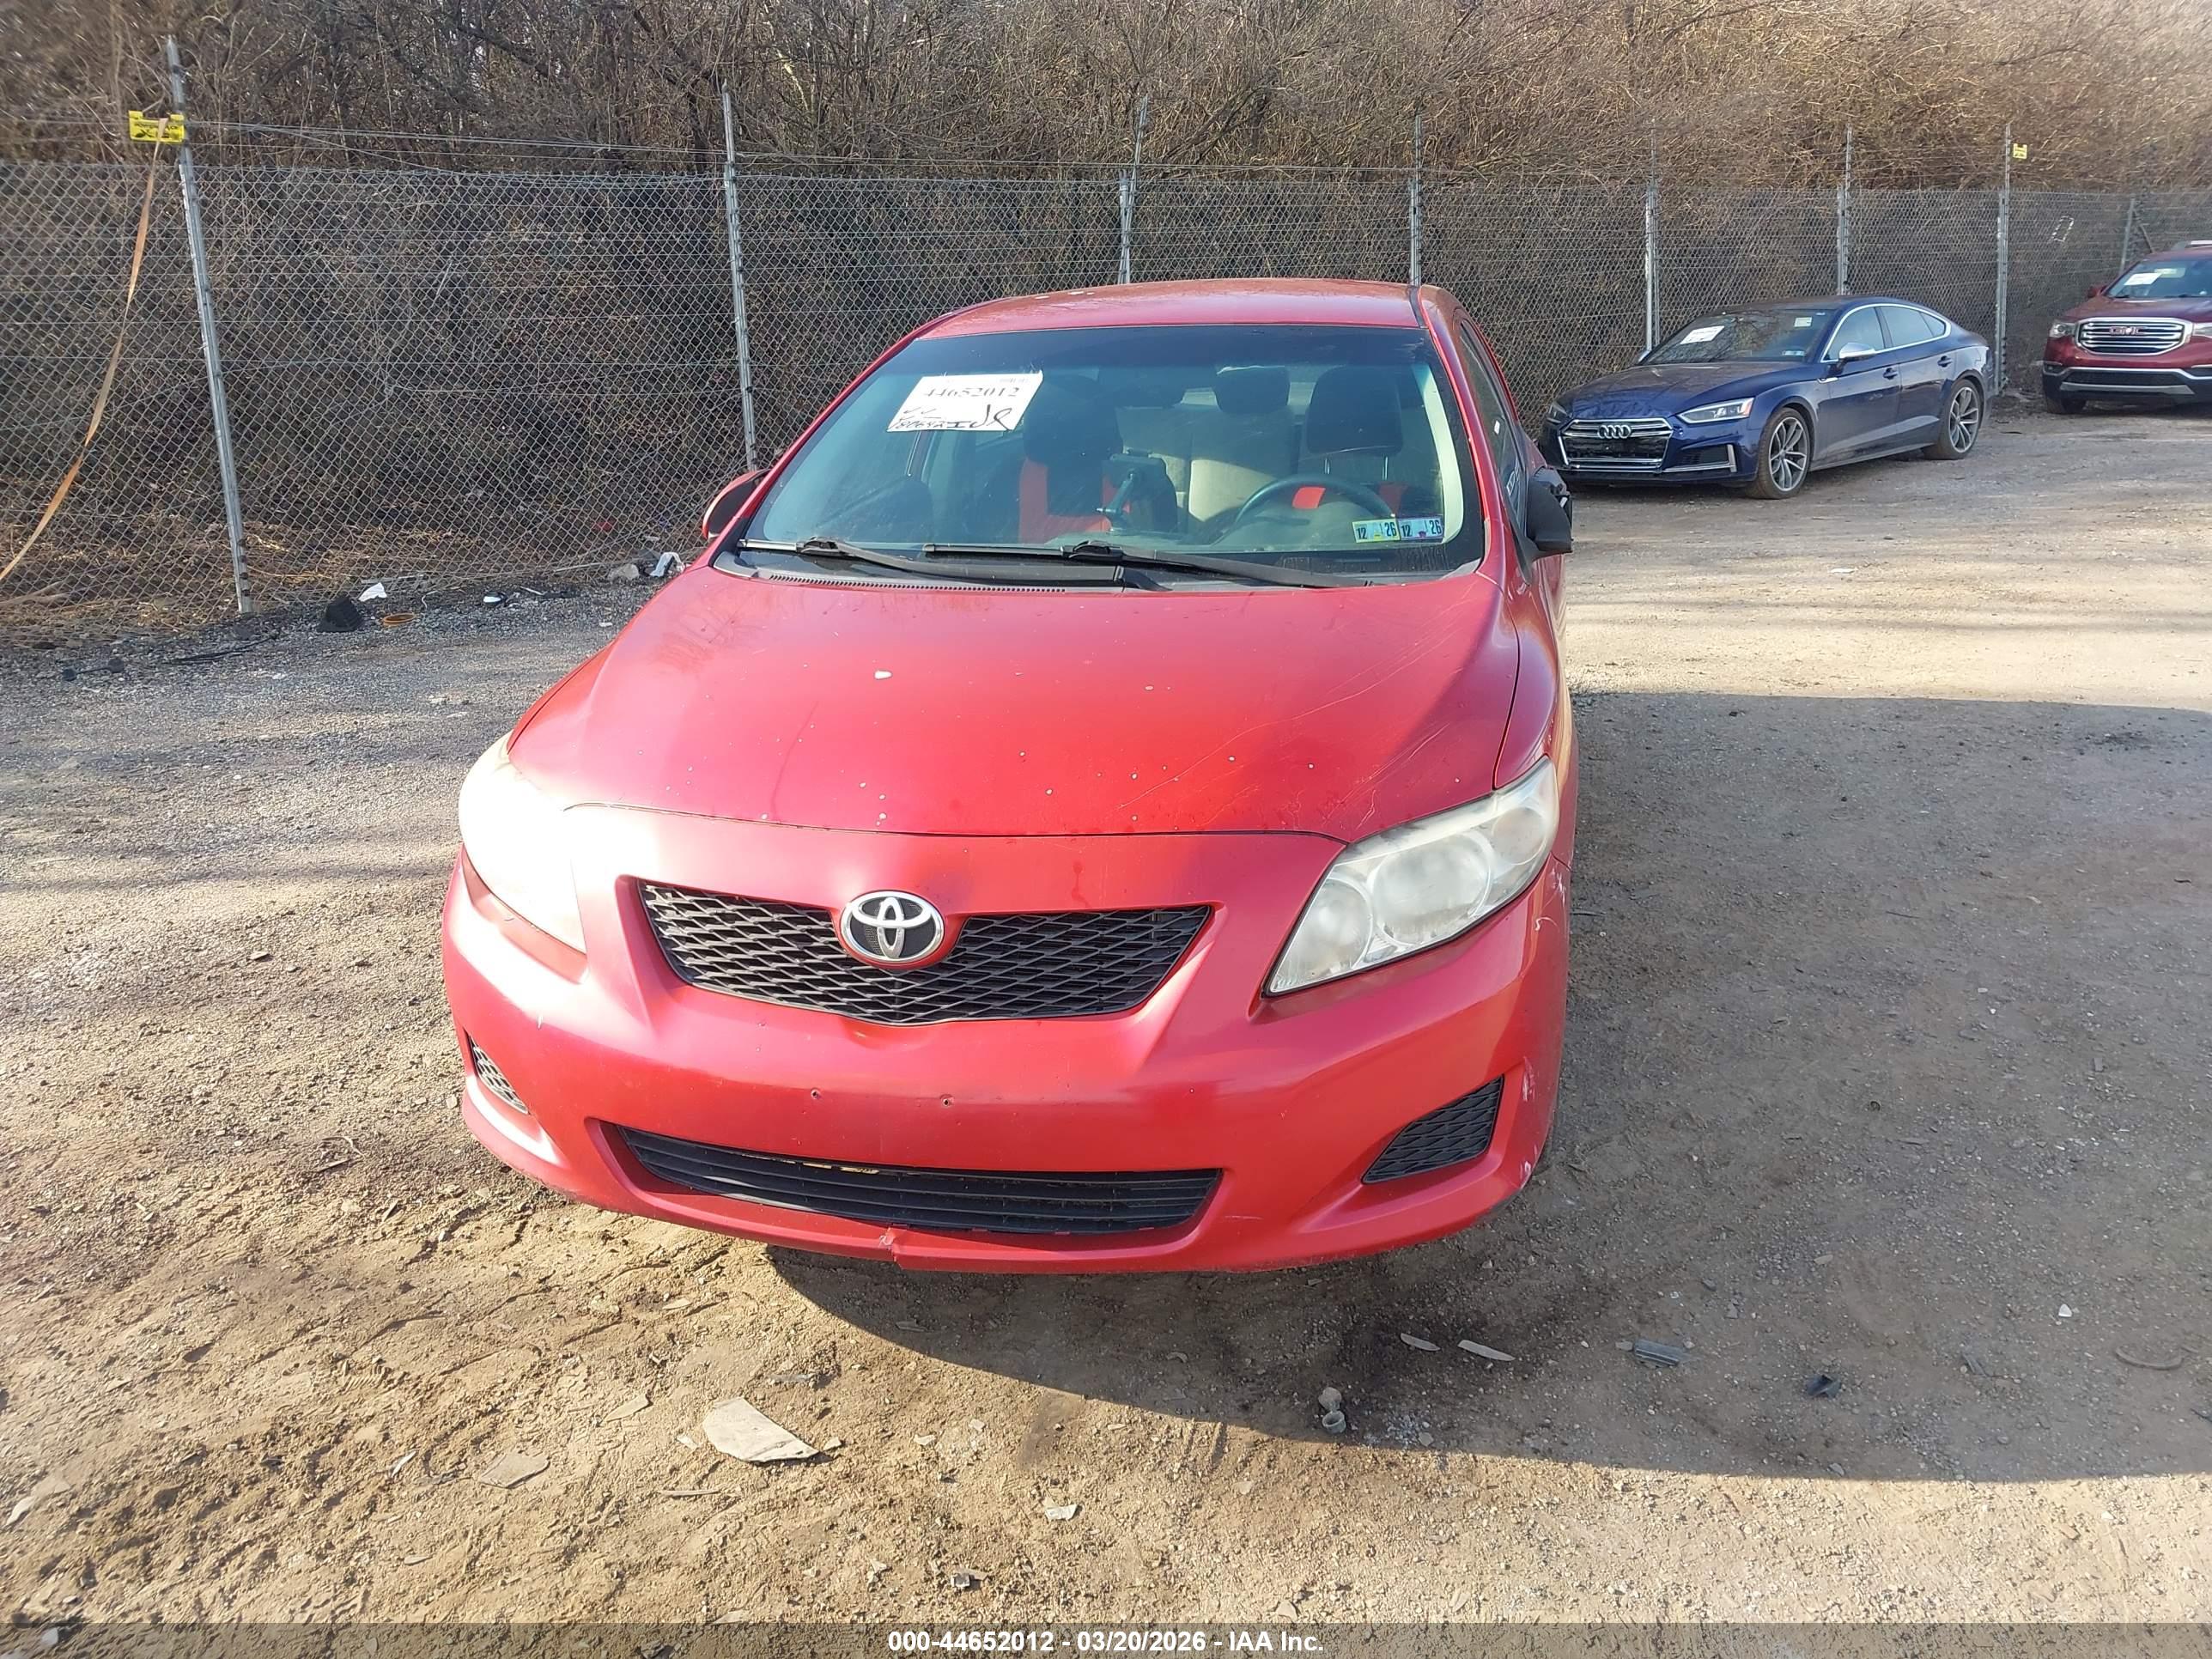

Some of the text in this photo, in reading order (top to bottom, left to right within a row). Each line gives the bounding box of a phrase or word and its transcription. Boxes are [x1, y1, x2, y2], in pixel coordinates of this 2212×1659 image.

[2109, 325, 2145, 336] GMC
[1356, 522, 1396, 540] 12 26
[1401, 520, 1442, 537] 12 26
